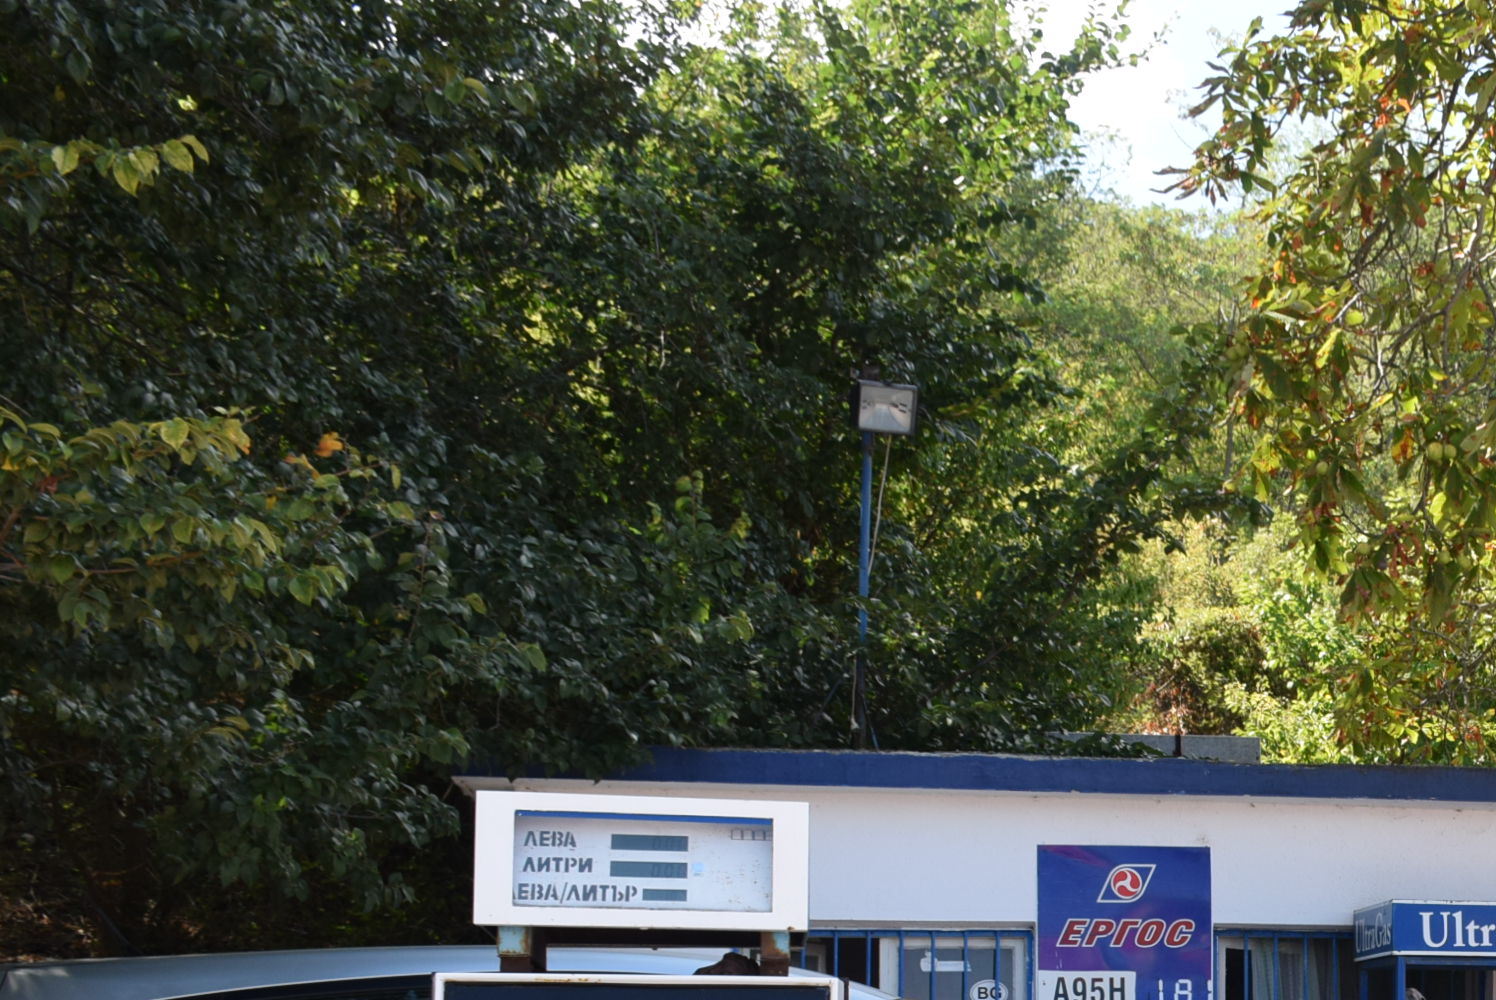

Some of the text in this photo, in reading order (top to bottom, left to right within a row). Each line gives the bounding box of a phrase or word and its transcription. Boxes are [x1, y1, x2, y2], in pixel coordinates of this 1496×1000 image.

[523, 830, 577, 848] ЛЕВА
[522, 856, 594, 873] ЛИТРИ
[1055, 918, 1196, 949] ЕРГОС
[977, 986, 1002, 1000] BG
